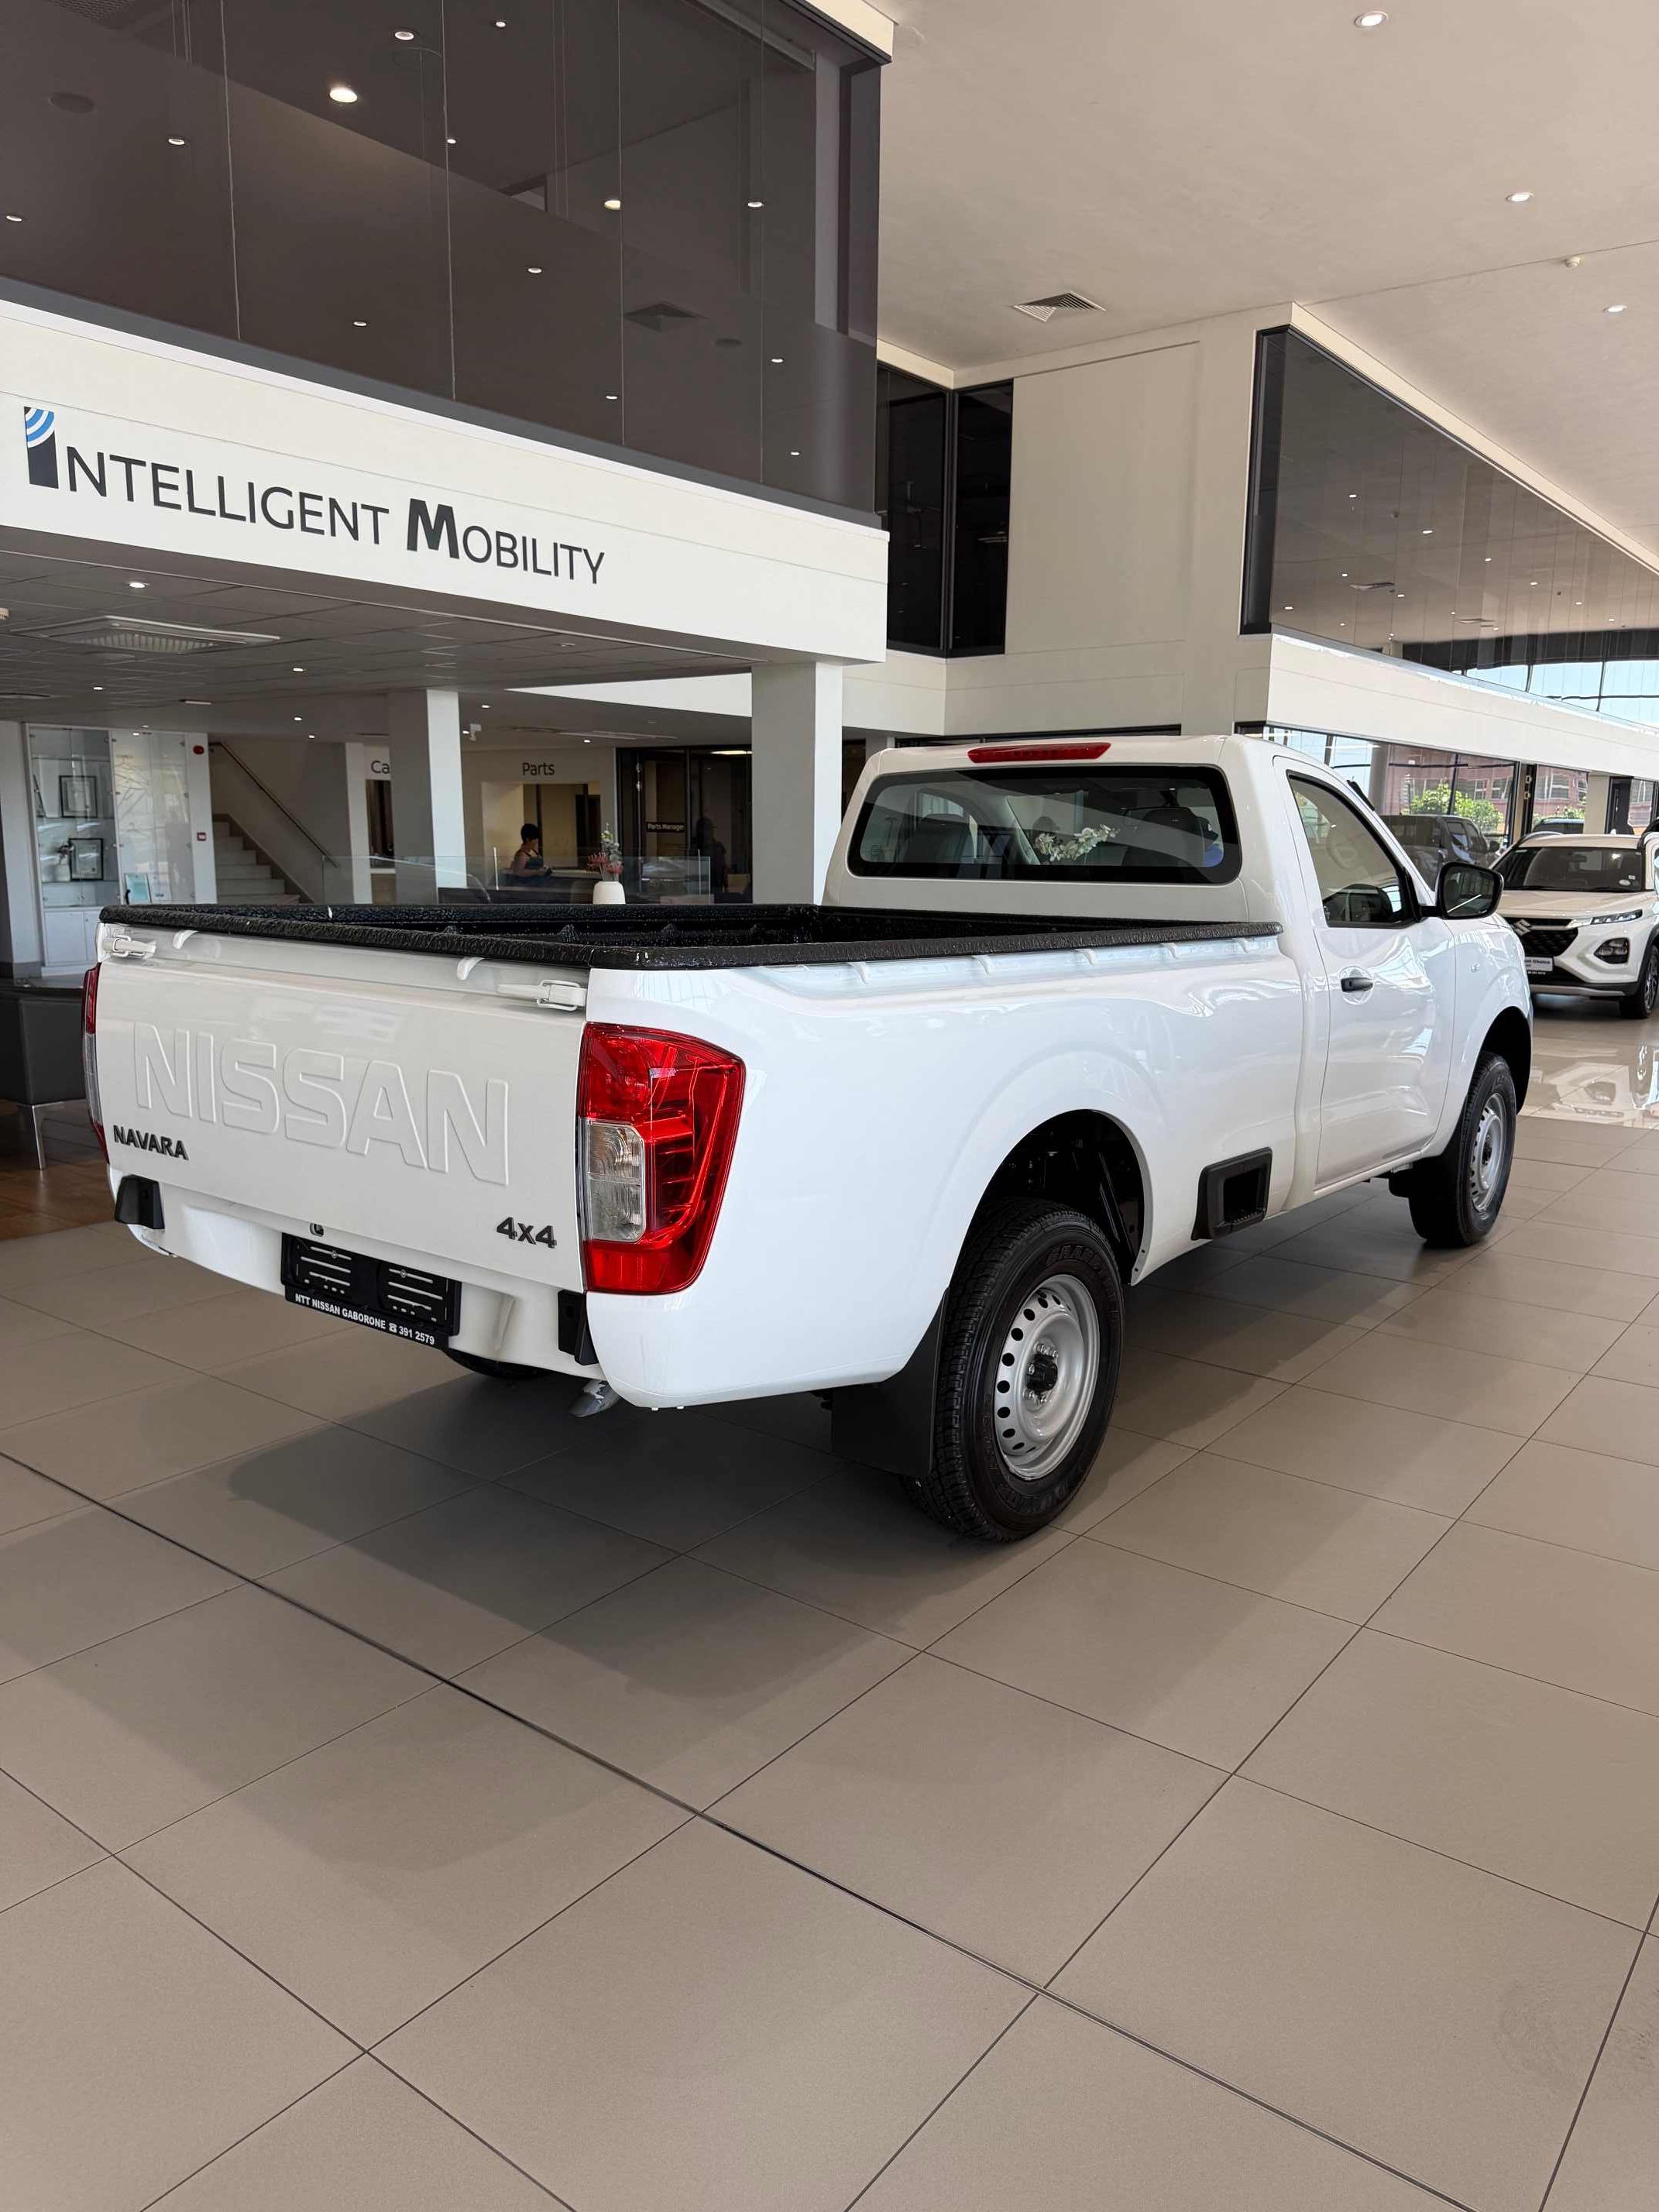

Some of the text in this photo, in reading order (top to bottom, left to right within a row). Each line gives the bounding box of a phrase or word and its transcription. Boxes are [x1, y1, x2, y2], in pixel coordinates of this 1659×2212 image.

[24, 407, 605, 584] INTELLIGENT MOBILITY
[371, 760, 390, 774] Ca
[522, 762, 555, 775] Parts
[134, 1022, 509, 1186] NISSAN
[113, 1124, 189, 1161] NAVARA
[295, 1293, 435, 1345] NTT NISSAN GABORONE 391 2579
